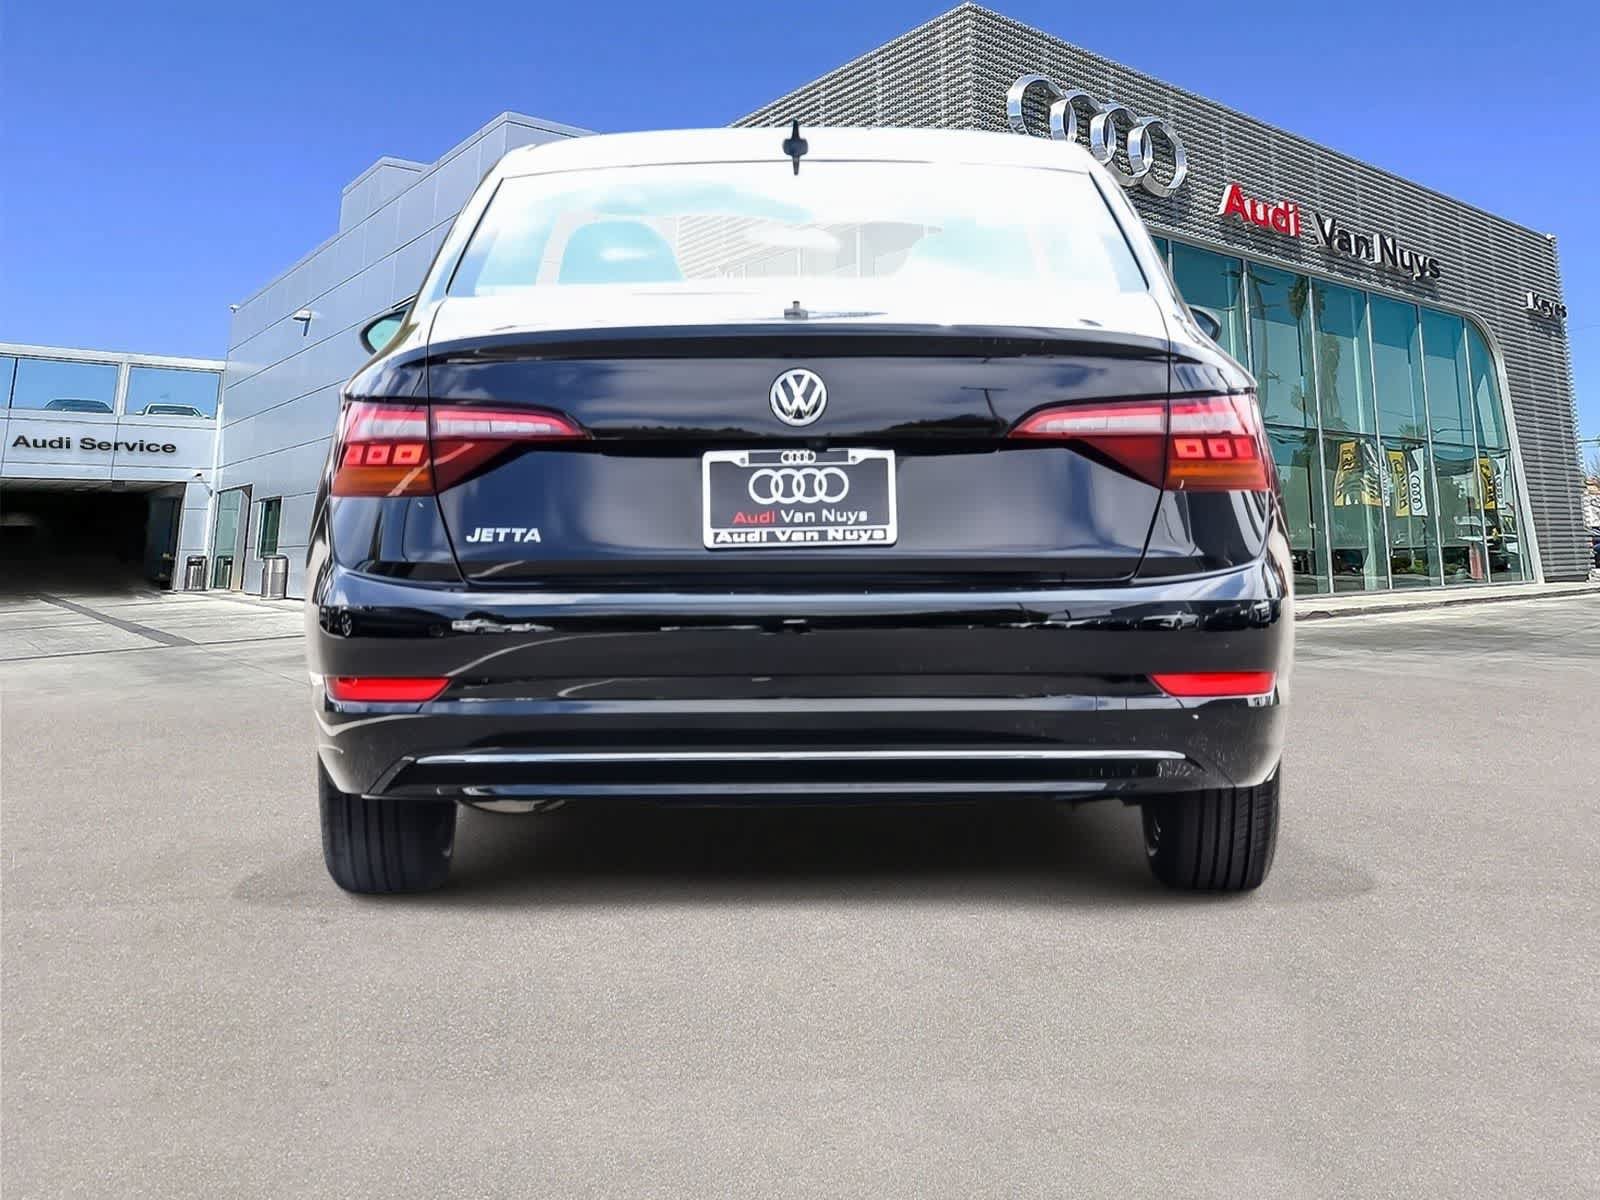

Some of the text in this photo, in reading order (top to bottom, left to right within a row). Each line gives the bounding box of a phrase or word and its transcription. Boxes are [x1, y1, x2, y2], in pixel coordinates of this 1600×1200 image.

[1217, 183, 1442, 281] Audi Van Nuys
[12, 435, 177, 454] Audi Service
[732, 508, 868, 525] Audi Van Nuys
[466, 527, 542, 543] JETTA
[715, 528, 887, 543] Audi Van Nuys
